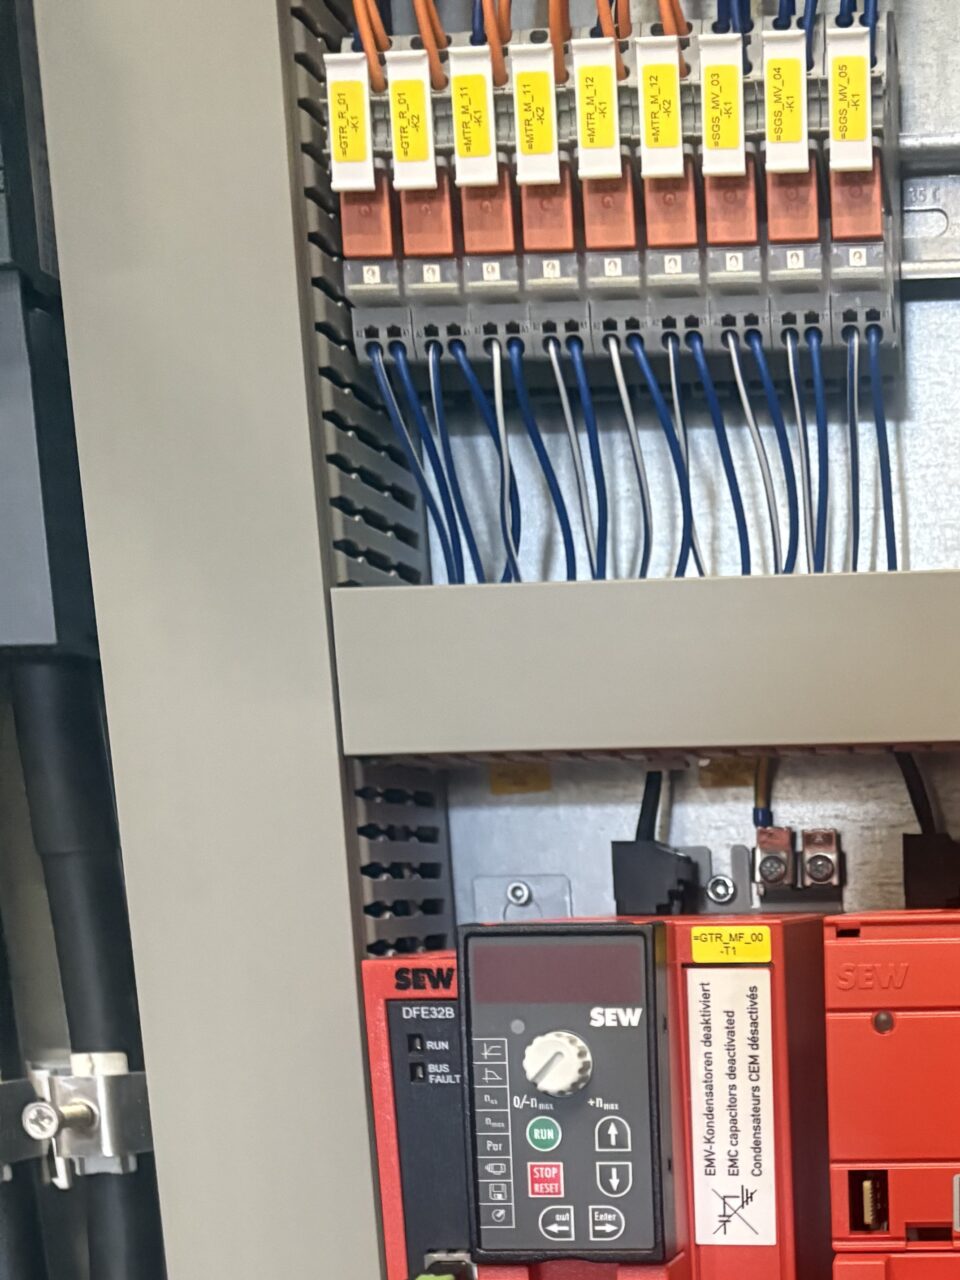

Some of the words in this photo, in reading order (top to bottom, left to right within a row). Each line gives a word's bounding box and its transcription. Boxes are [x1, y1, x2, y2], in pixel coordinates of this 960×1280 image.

[599, 101, 607, 119] -K1
[663, 99, 672, 118] -K2
[710, 73, 723, 147] =SGS_MV_03
[724, 101, 733, 119] -K1
[773, 66, 785, 141] =SGS_MV_04
[786, 95, 795, 113] -K1
[838, 64, 850, 140] =SGS_MV_05
[851, 93, 860, 111] -K1
[693, 932, 764, 946] =GTR_MF_00
[720, 946, 737, 956] -T1
[394, 967, 455, 990] SEW
[836, 963, 908, 991] SEW
[401, 1006, 455, 1019] DFE32B
[589, 1006, 642, 1027] SEW
[699, 982, 712, 1047] deaktiviert
[746, 985, 759, 1051] désactivés
[426, 1041, 449, 1050] RUN
[724, 1010, 737, 1080] deactivated
[428, 1064, 449, 1073] BUS
[748, 1054, 760, 1082] CEM
[428, 1074, 461, 1084] FAULT
[702, 1051, 716, 1176] EMV-Kondensatoren
[725, 1084, 741, 1147] capacitors
[533, 1129, 555, 1140] RUN
[749, 1085, 762, 1177] Condensateurs
[728, 1148, 739, 1176] EMC
[533, 1167, 558, 1178] STOP
[534, 1183, 559, 1193] RESET
[594, 1211, 617, 1221] Enter
